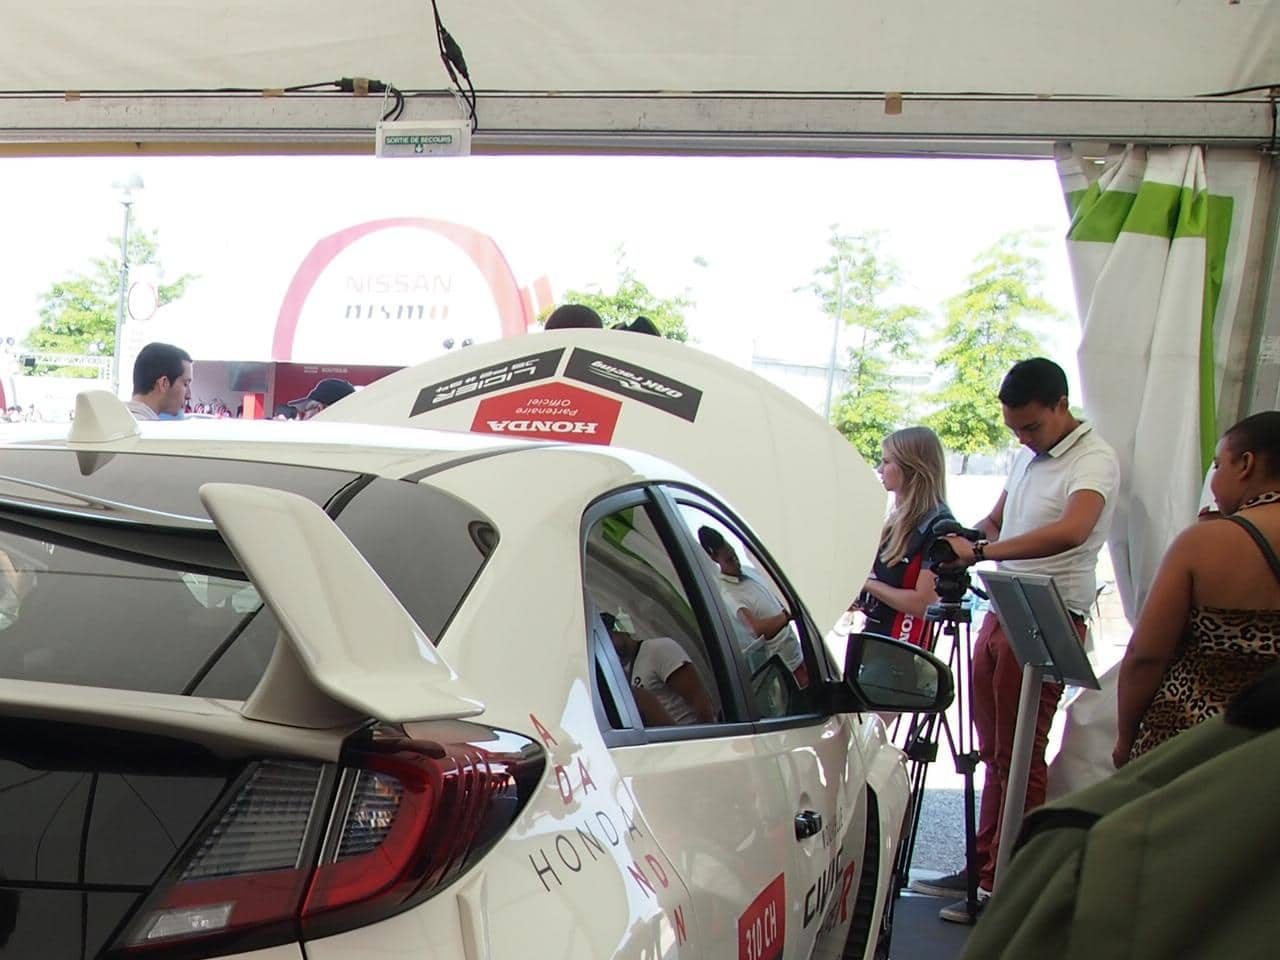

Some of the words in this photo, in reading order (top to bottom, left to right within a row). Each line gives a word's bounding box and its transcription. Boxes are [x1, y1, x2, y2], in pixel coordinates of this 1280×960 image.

[421, 136, 451, 144] SECOURS
[345, 274, 454, 293] NISSAN
[432, 365, 537, 404] LIGIER
[528, 399, 571, 407] Officiel
[516, 407, 578, 417] Partenaire
[487, 420, 598, 434] HONDA
[529, 806, 643, 892] HONDA
[764, 901, 777, 948] CH
